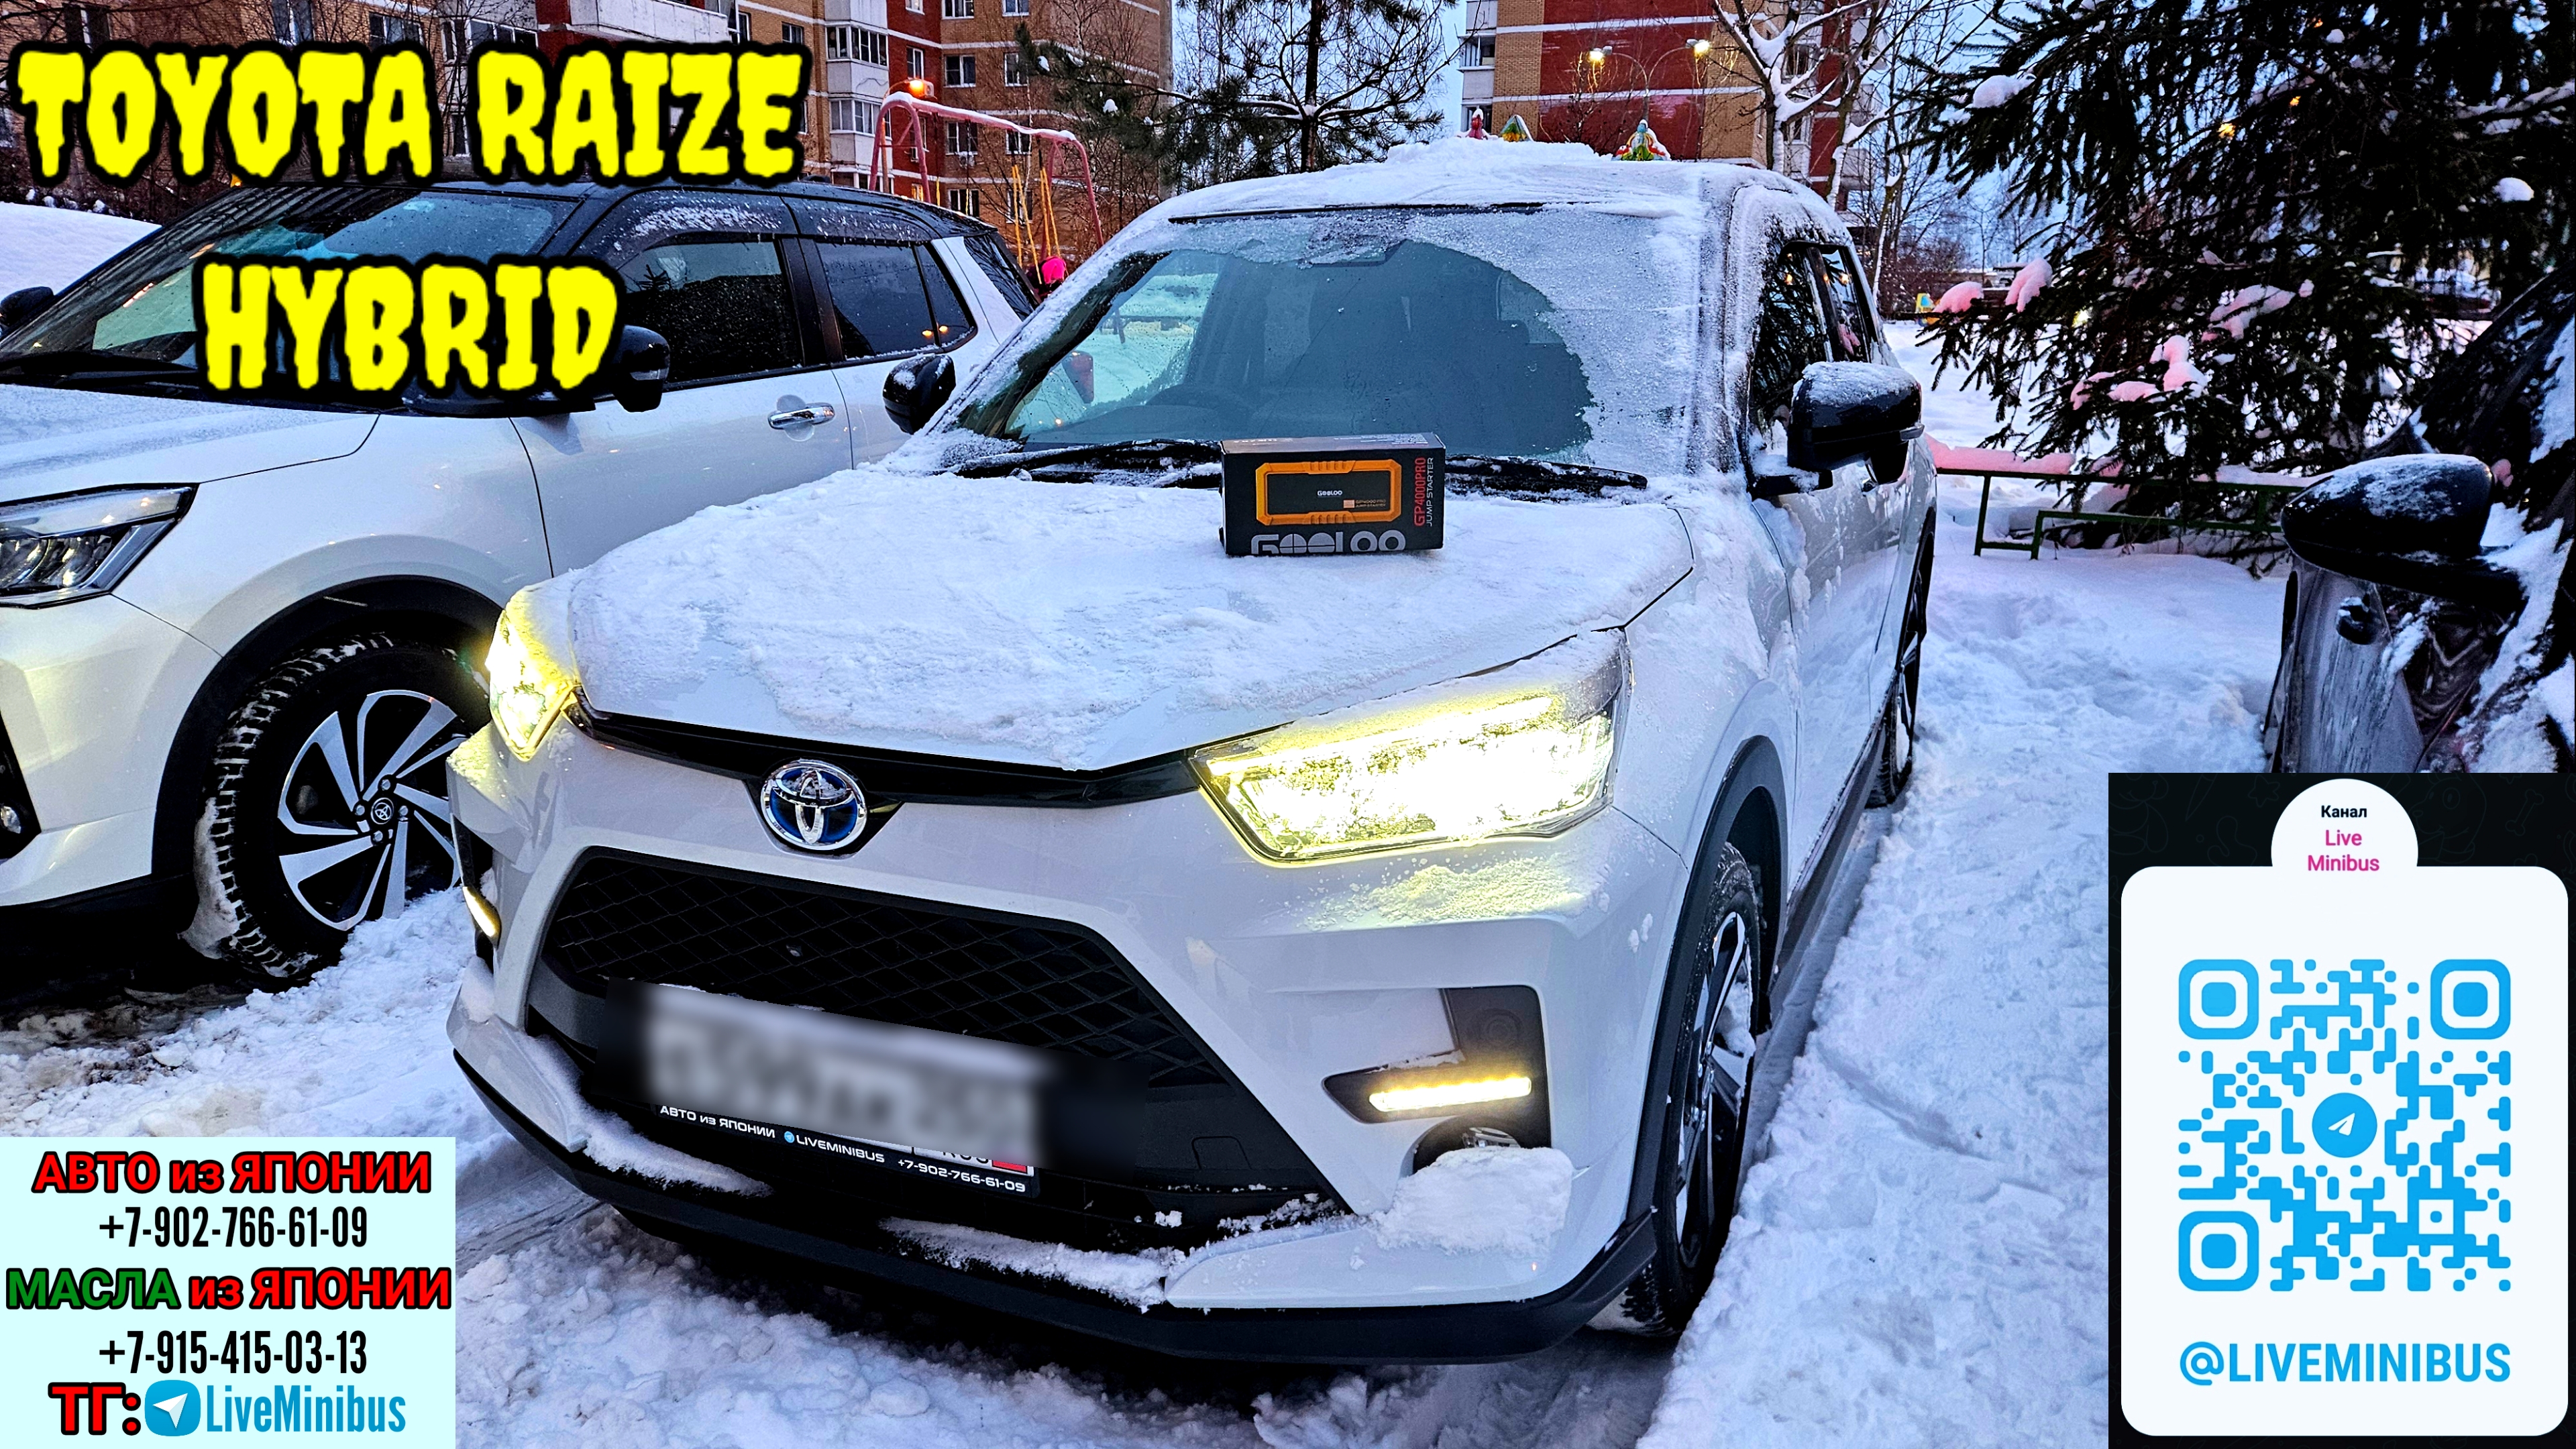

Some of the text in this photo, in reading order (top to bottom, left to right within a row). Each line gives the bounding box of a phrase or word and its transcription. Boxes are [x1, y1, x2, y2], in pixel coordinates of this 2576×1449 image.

[1414, 458, 1426, 527] GP4000PRO
[660, 1106, 696, 1121] АВТО
[719, 1118, 775, 1138] ЯПОНИИ
[796, 1134, 885, 1163] LIVEMINIBUS
[898, 1159, 1026, 1193] +7-902-766-61-09
